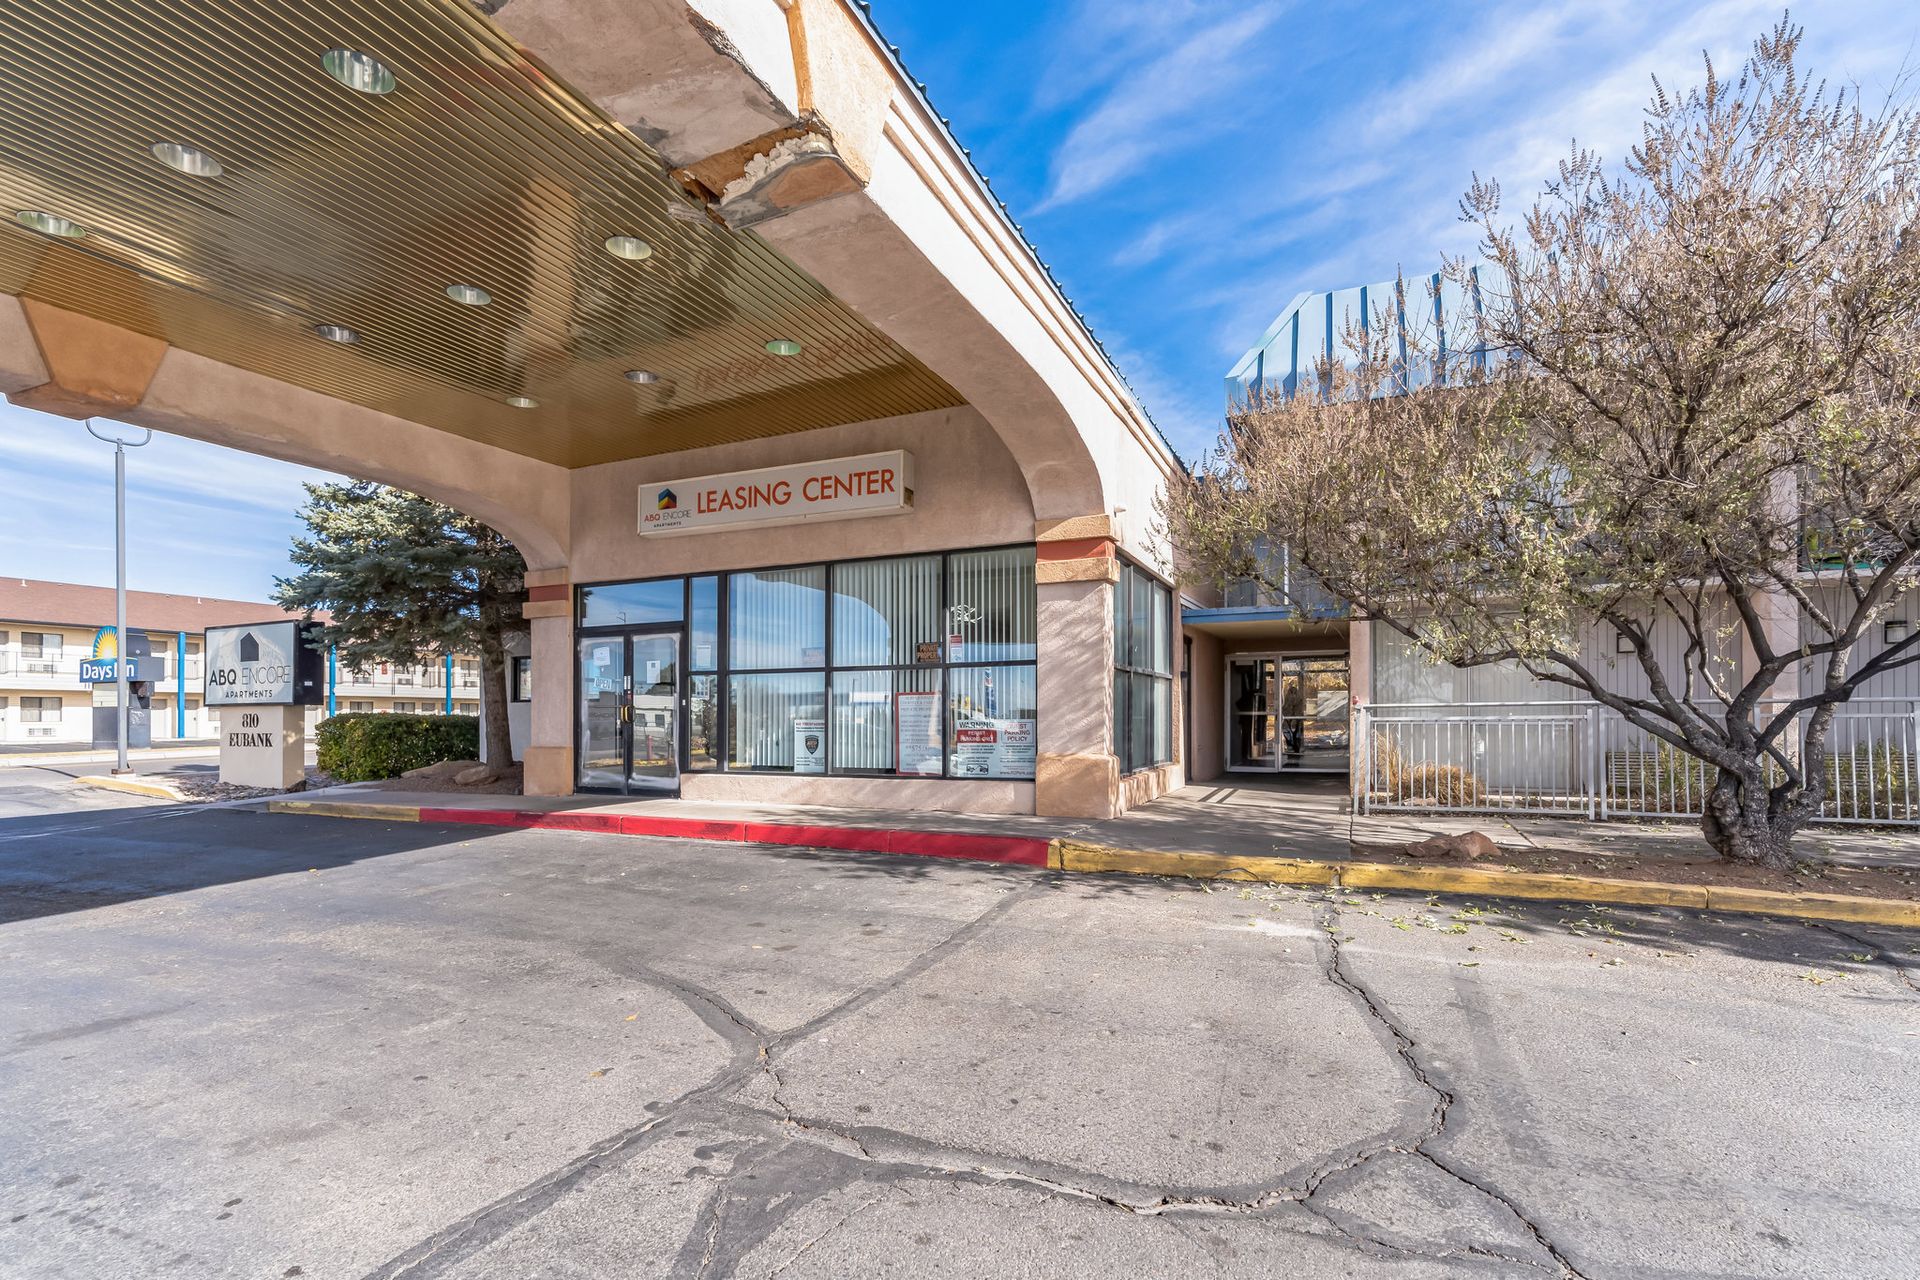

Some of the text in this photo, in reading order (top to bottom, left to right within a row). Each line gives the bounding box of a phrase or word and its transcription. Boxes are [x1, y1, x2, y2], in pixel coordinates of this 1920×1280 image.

[697, 468, 895, 514] LEASING CENTER
[644, 509, 692, 522] ABQ ENCORE
[82, 662, 135, 680] Days In
[209, 665, 291, 687] ABQ ENCORE
[225, 689, 273, 698] APARTMENTS
[241, 713, 259, 728] 810
[229, 732, 273, 747] EUBANK
